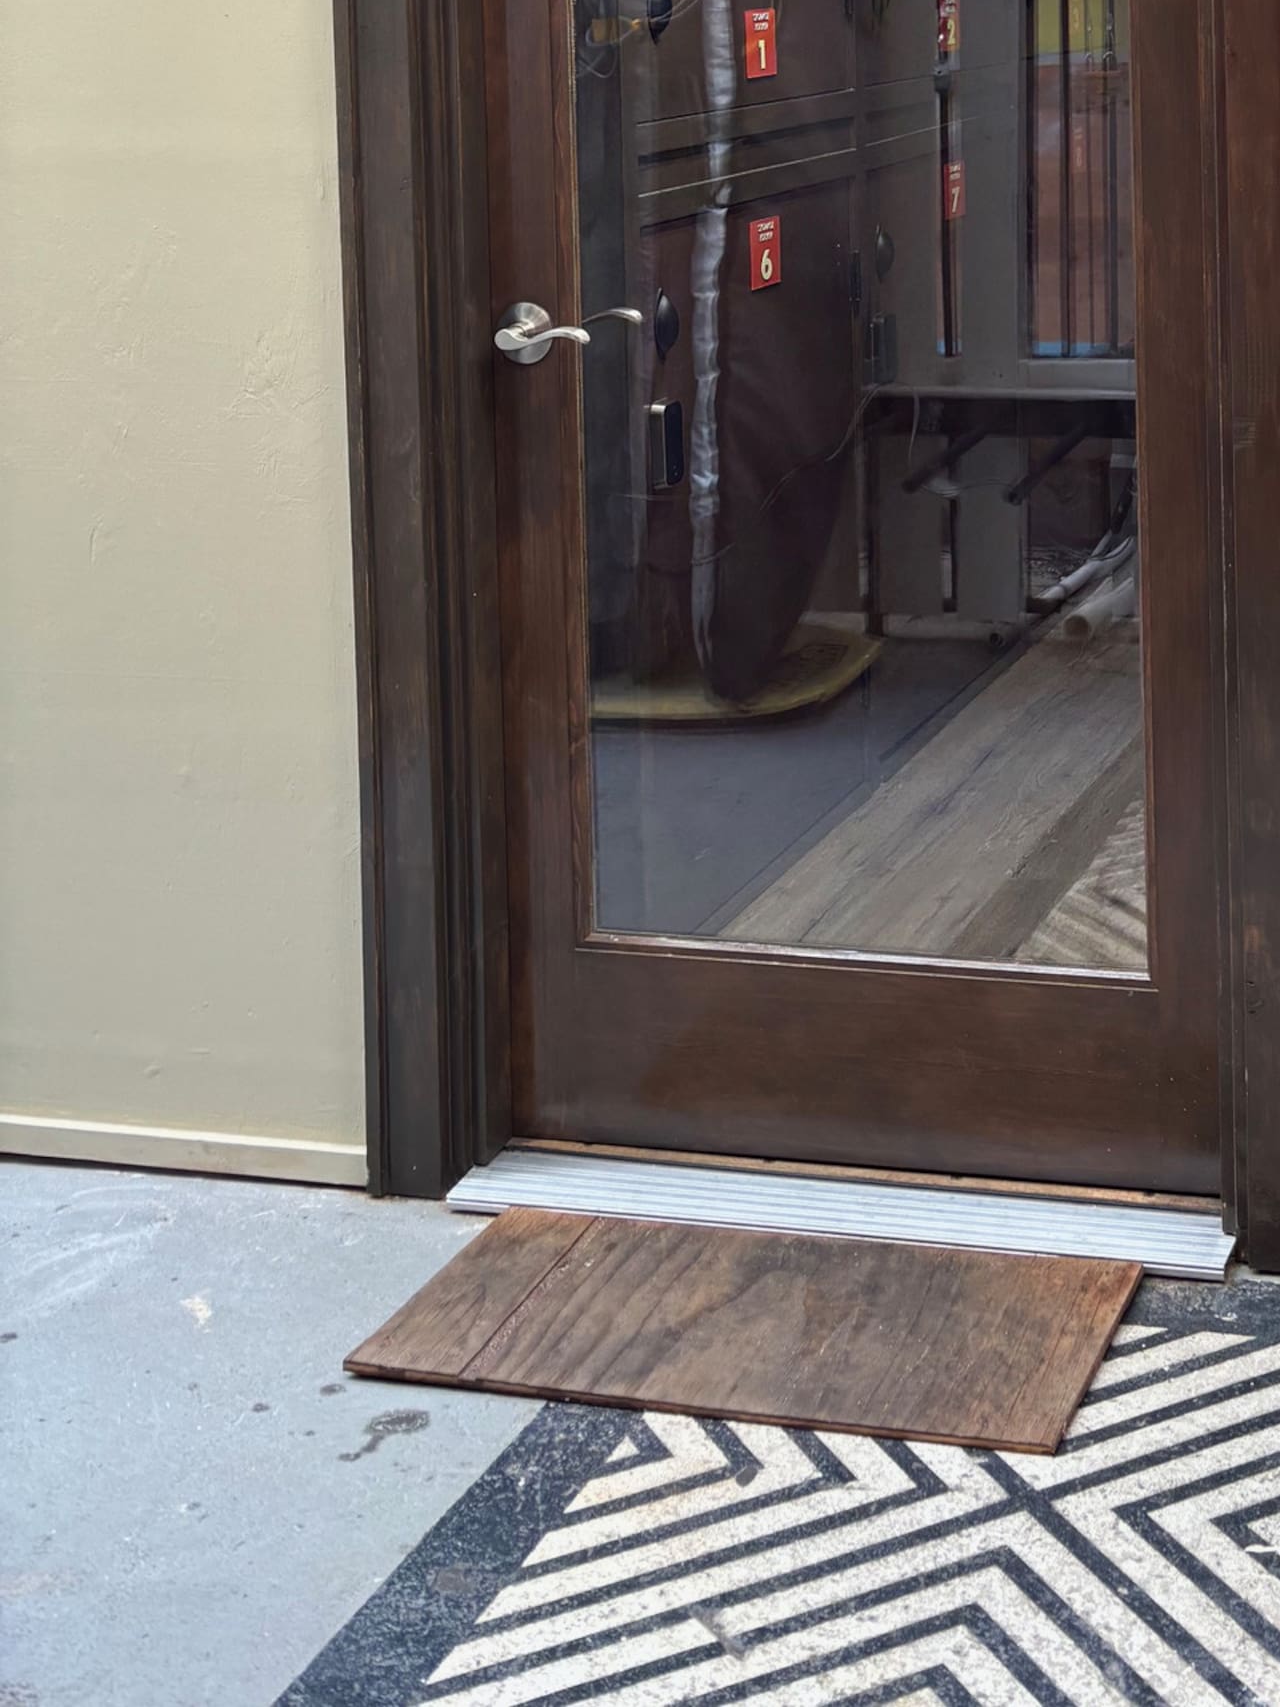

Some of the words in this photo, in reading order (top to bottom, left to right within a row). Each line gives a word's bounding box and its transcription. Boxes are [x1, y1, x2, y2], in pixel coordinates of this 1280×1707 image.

[946, 18, 956, 45] 2
[758, 38, 766, 70] 1
[951, 186, 960, 213] 7
[761, 248, 773, 281] 6
